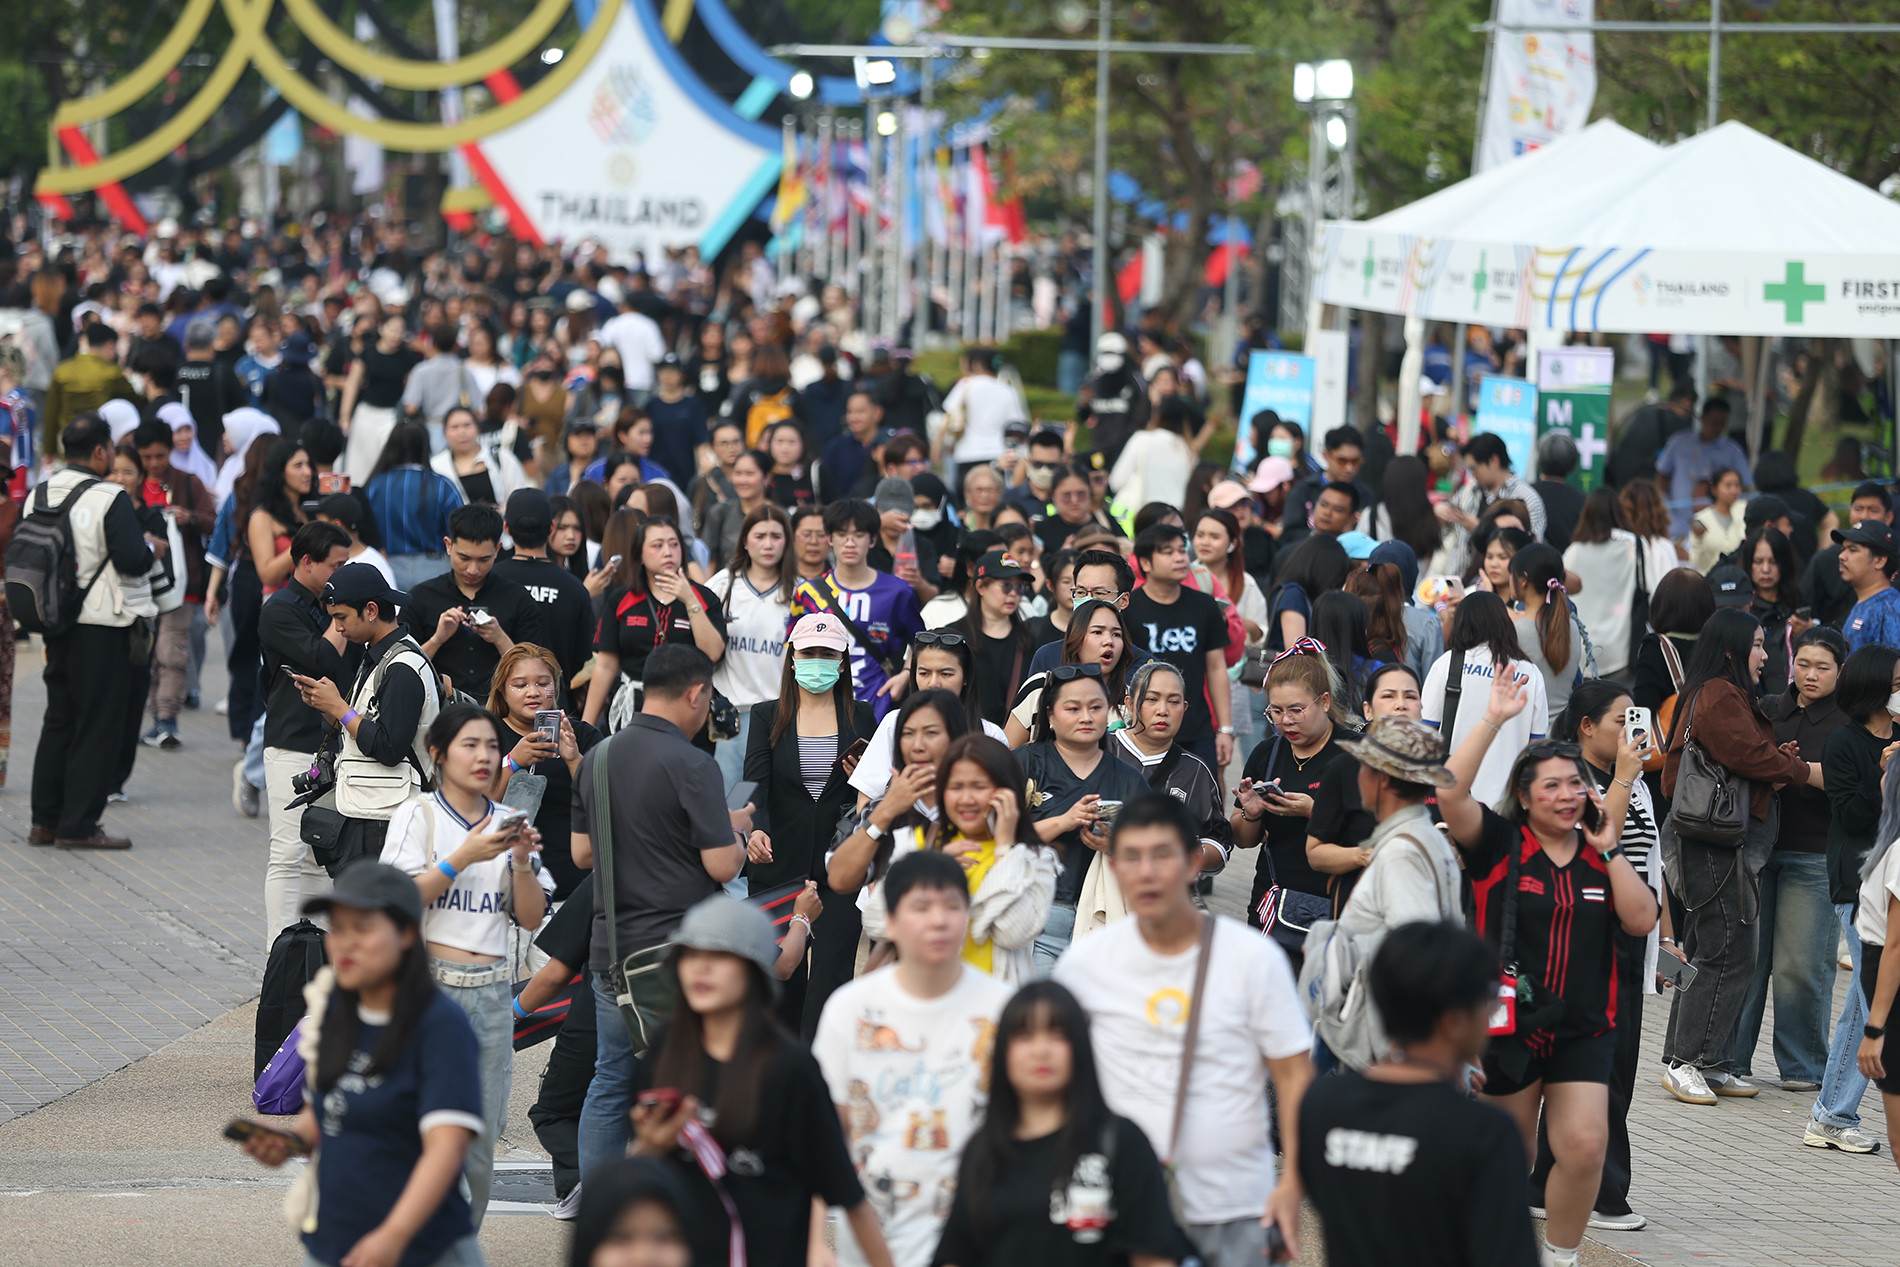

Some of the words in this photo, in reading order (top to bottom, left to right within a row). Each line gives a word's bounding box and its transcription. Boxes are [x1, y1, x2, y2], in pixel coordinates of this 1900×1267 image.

[539, 191, 706, 229] THAILAND
[1842, 281, 1900, 298] FIRST
[524, 585, 559, 604] AFF
[728, 635, 784, 657] HAILAND
[1143, 622, 1197, 653] Lee
[1324, 1126, 1419, 1175] STAFF
